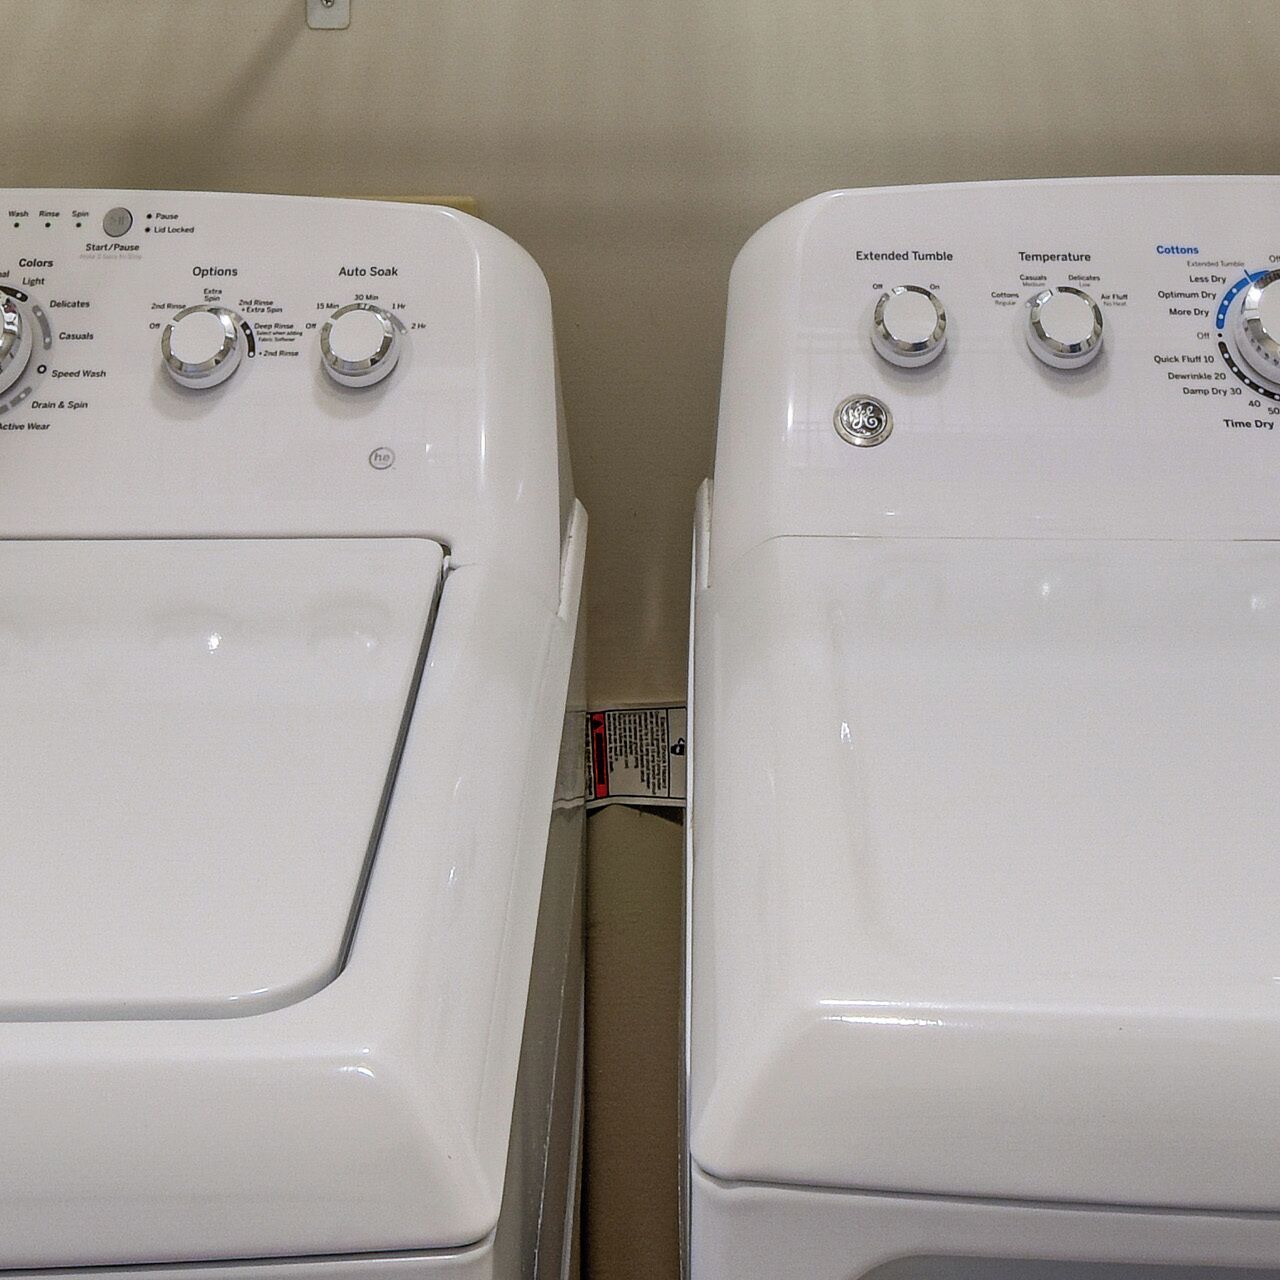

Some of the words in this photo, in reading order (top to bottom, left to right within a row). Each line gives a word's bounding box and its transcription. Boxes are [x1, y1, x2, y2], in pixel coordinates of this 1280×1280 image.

[72, 210, 89, 218] Spin
[85, 243, 140, 252] Start/Pause
[1156, 246, 1199, 255] Cottons
[856, 250, 909, 262] Extended
[912, 250, 953, 262] Tumble
[1019, 252, 1091, 264] Temperature
[19, 258, 54, 267] Colors
[192, 266, 238, 278] Options
[339, 267, 366, 276] Auto
[370, 267, 398, 276] Soak
[22, 277, 45, 287] Light
[1189, 275, 1209, 283] Less
[1211, 275, 1226, 284] Dry
[1158, 290, 1200, 299] Optimum
[1201, 290, 1216, 300] Dry
[49, 300, 90, 308] Delicates
[1194, 308, 1209, 317] Dry
[59, 332, 94, 340] Casuals
[1154, 355, 1179, 364] Quick
[1181, 355, 1202, 363] Fluff
[1204, 355, 1214, 363] 10
[51, 370, 80, 378] Speed
[1168, 372, 1212, 380] Dewrinkle
[1183, 387, 1209, 397] Damp
[1212, 387, 1227, 397] Dry
[1230, 387, 1242, 395] 30
[31, 401, 59, 409] Drain
[67, 401, 88, 410] Spin
[1248, 400, 1261, 408] 40
[1268, 407, 1280, 415] 50
[27, 423, 51, 431] Wear
[1223, 419, 1251, 428] Time
[1254, 419, 1274, 431] Dry
